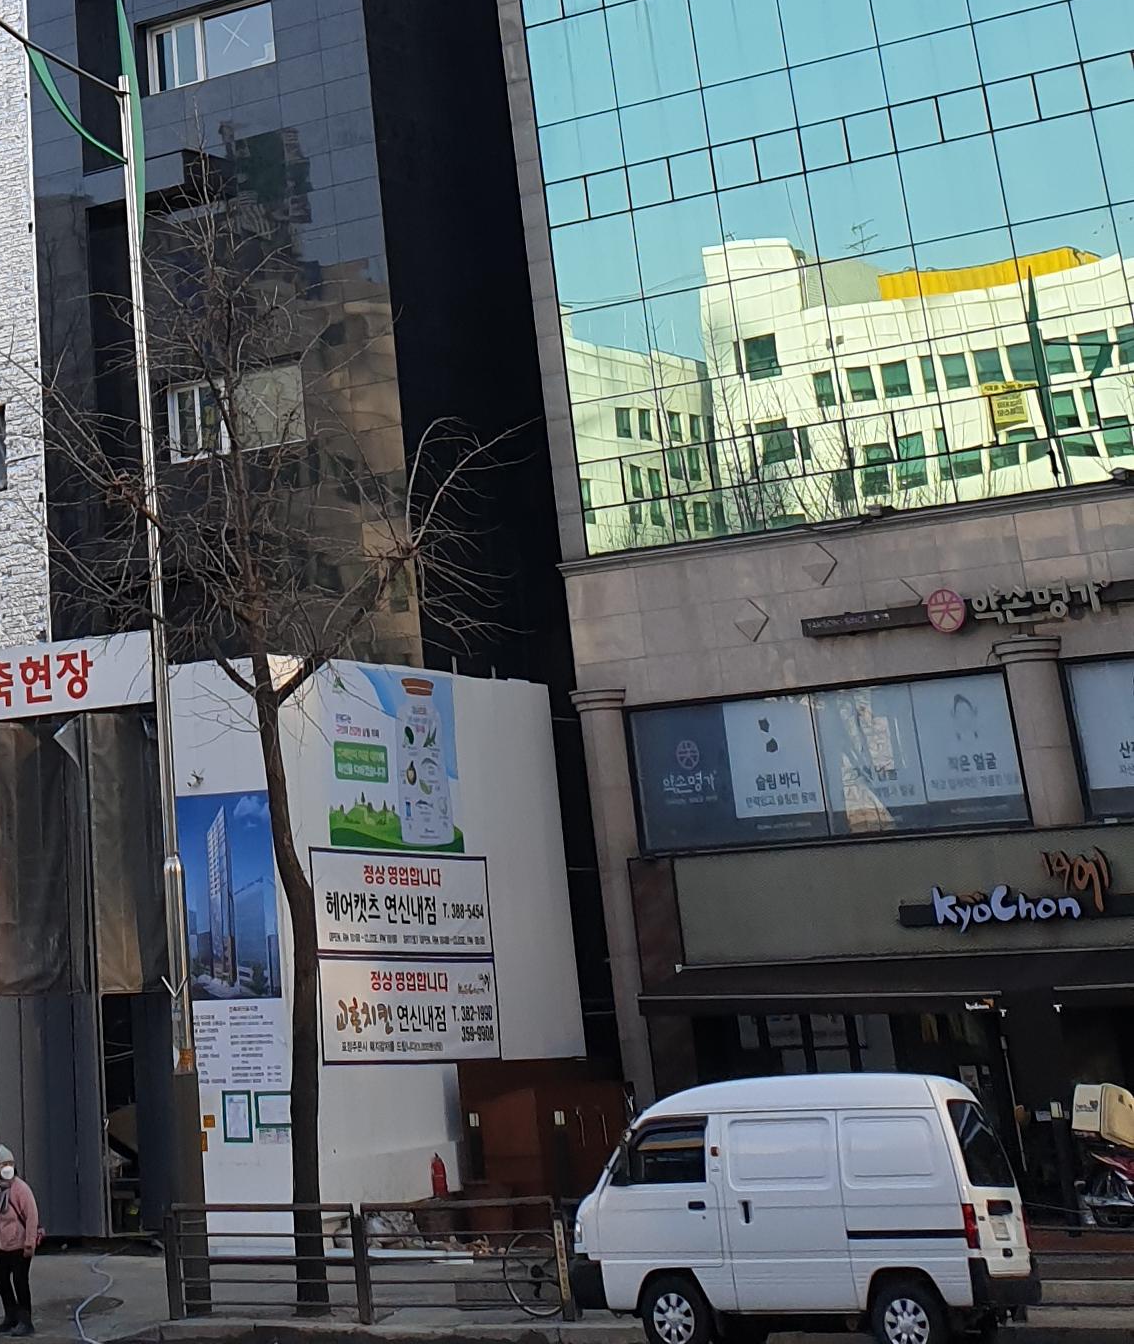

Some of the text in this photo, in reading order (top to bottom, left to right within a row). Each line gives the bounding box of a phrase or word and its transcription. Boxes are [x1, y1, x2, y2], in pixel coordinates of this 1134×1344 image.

[971, 578, 1106, 625] 약손명가
[779, 771, 801, 789] 바디
[363, 865, 442, 887] 정상 영업합니다
[325, 891, 381, 923] 헤어캣츠
[384, 894, 437, 925] 연신내점
[370, 970, 449, 993] 정상 영업합니다
[396, 1005, 448, 1033] 연신내점
